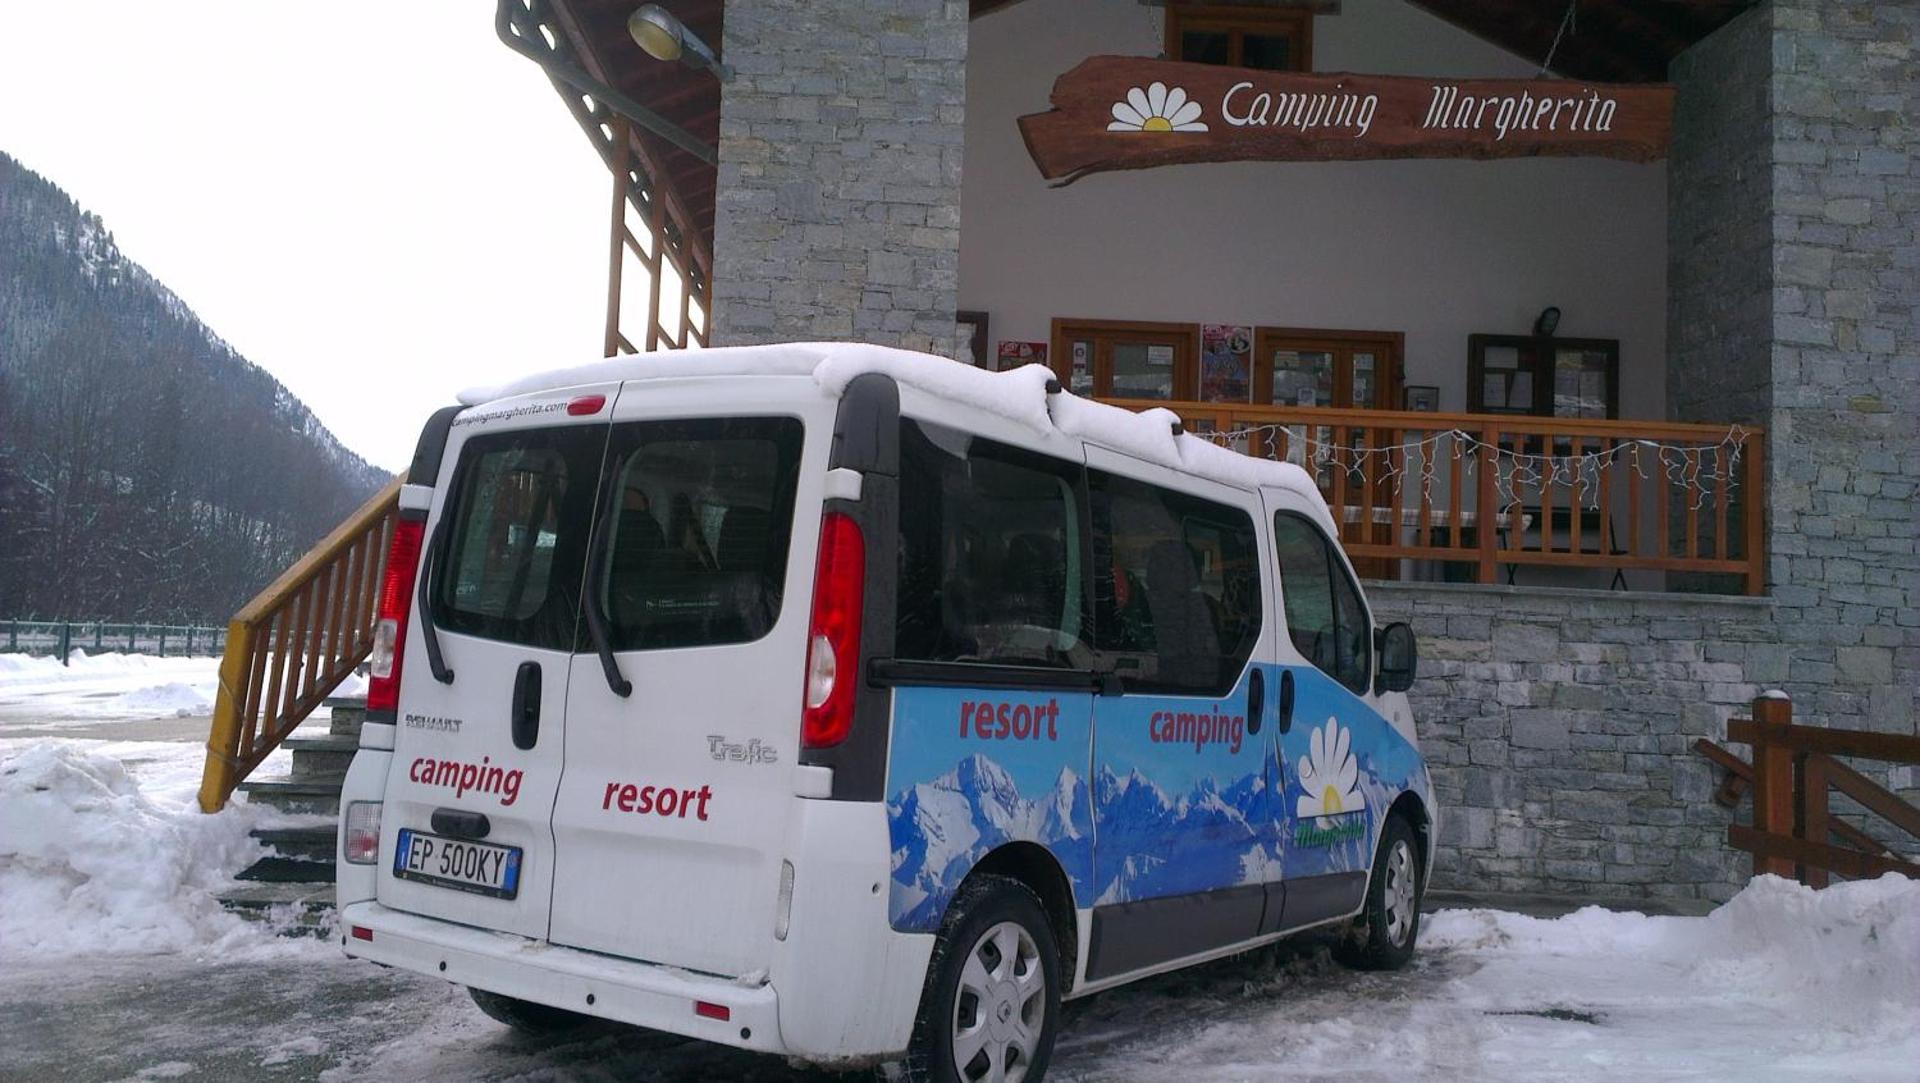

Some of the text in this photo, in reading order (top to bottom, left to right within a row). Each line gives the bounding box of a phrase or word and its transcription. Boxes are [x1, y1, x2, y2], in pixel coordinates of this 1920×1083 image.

[1221, 81, 1617, 141] Camping Margherita
[960, 698, 1059, 741] resort
[1150, 704, 1244, 755] camping
[706, 735, 779, 765] Trafic
[410, 756, 525, 806] camping
[603, 781, 712, 821] resort
[408, 837, 505, 885] EP 500KY
